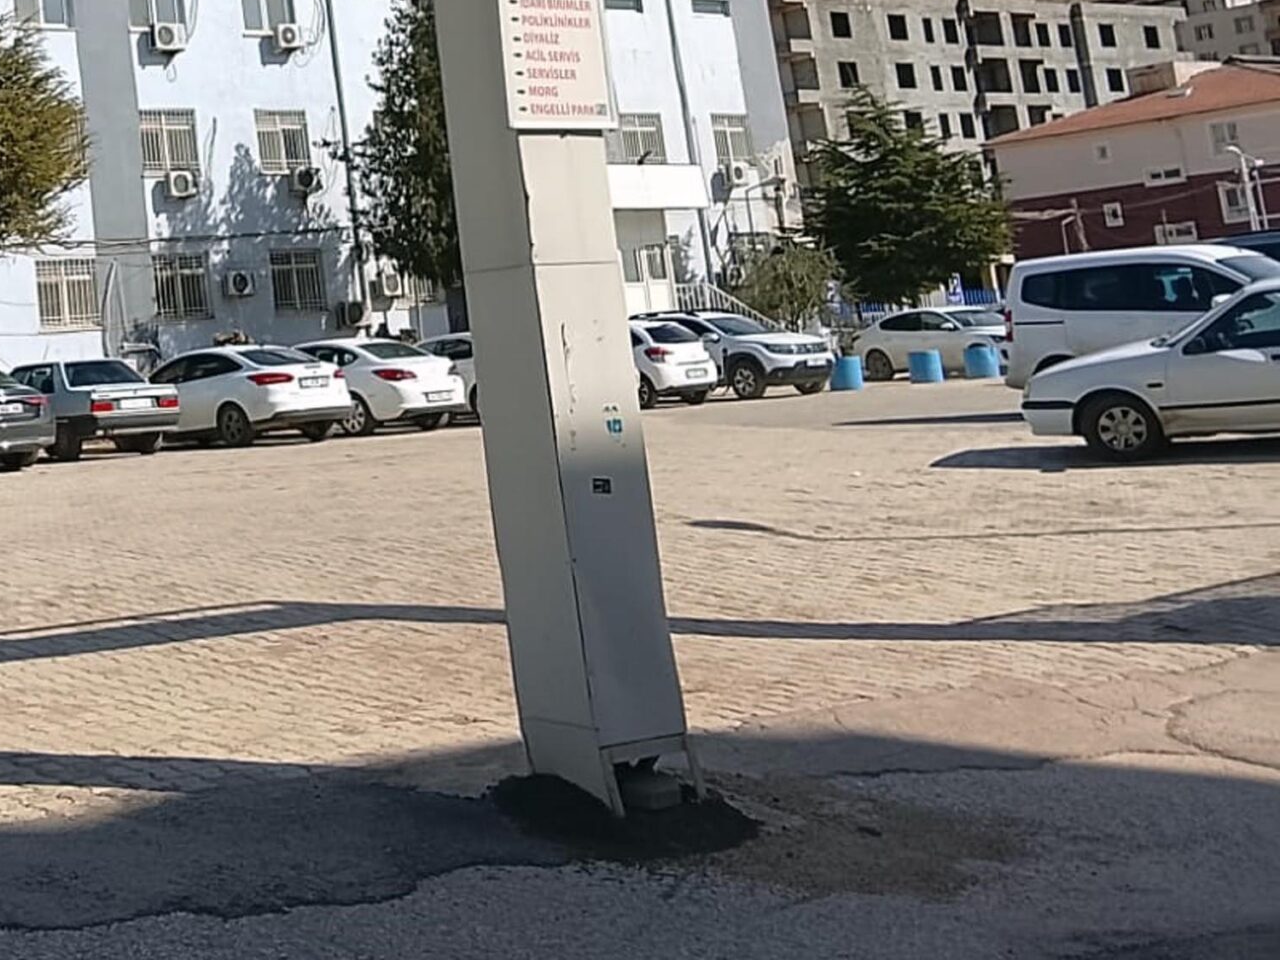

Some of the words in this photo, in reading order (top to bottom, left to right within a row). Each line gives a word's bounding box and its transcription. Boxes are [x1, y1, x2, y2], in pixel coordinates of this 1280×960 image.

[522, 14, 591, 29] POLİKLİNİKLER
[523, 31, 560, 45] DİYALİZ
[525, 49, 547, 62] ACİL
[548, 50, 582, 63] SERVİS
[526, 66, 577, 80] SERVİSLER
[528, 86, 559, 98] MORG
[530, 102, 570, 116] ENGELLİ
